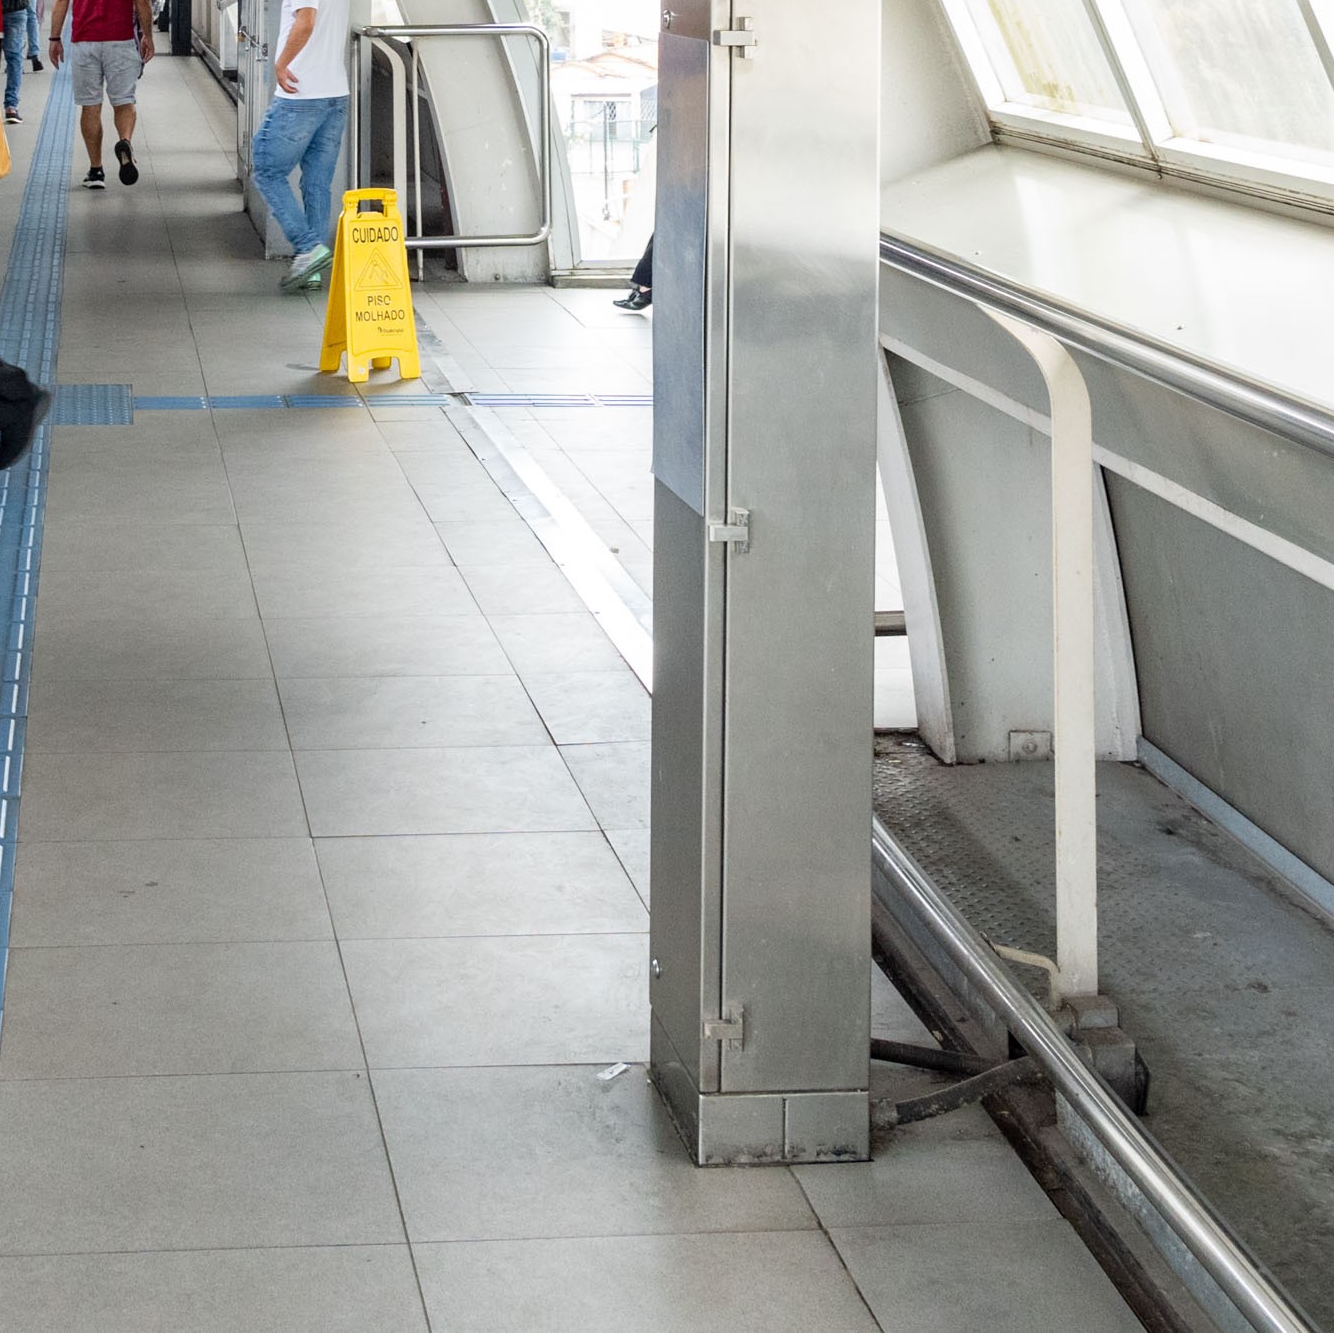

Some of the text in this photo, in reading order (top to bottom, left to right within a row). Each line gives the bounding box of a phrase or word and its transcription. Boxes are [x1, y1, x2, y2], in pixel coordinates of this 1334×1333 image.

[352, 226, 399, 244] CUIDADO
[367, 295, 391, 306] PISO
[355, 309, 406, 322] MOLHADO
